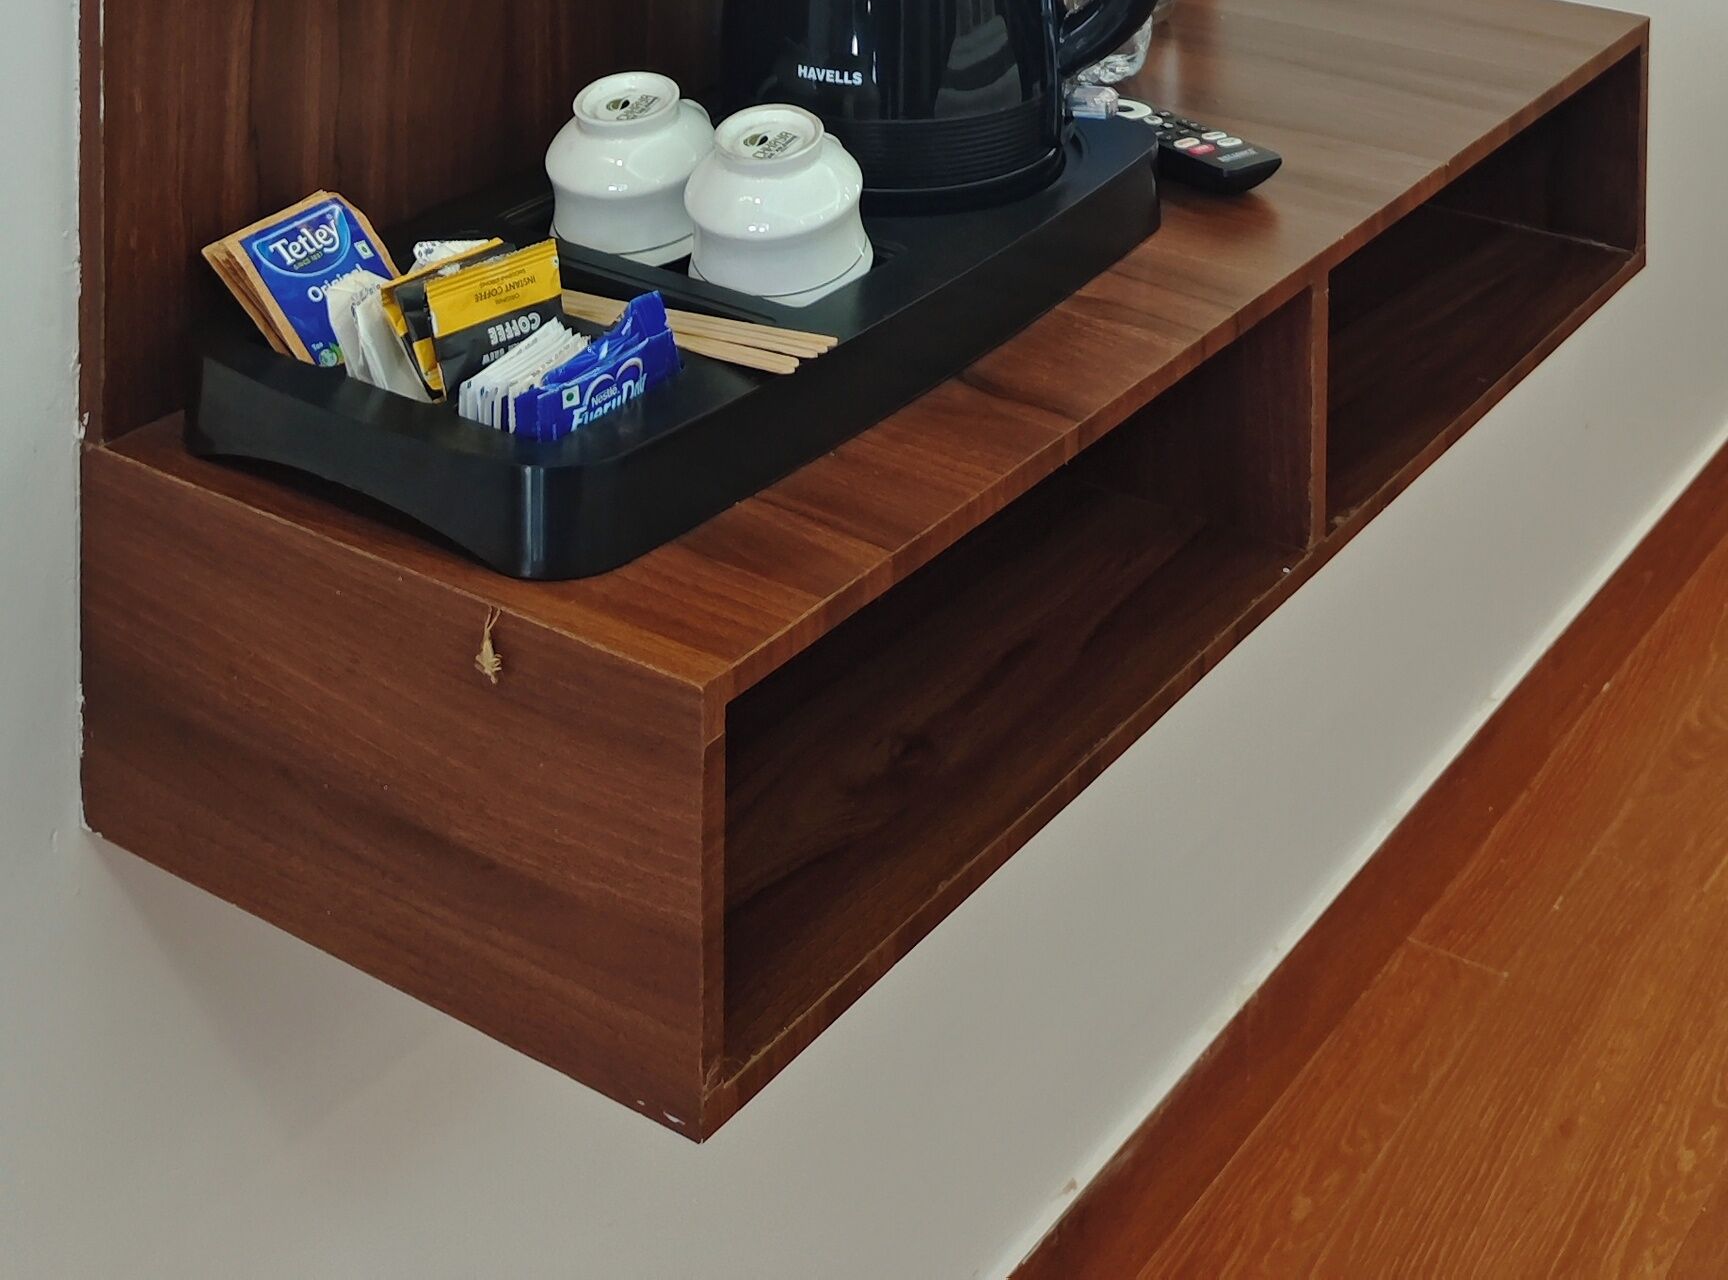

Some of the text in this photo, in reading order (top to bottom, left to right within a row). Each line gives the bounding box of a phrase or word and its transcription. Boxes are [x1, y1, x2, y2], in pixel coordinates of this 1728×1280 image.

[798, 64, 863, 86] HAVELLS
[269, 219, 340, 265] Tetley
[474, 286, 504, 303] COFFEE
[505, 276, 536, 293] INSTANT
[487, 312, 541, 346] COFFEE
